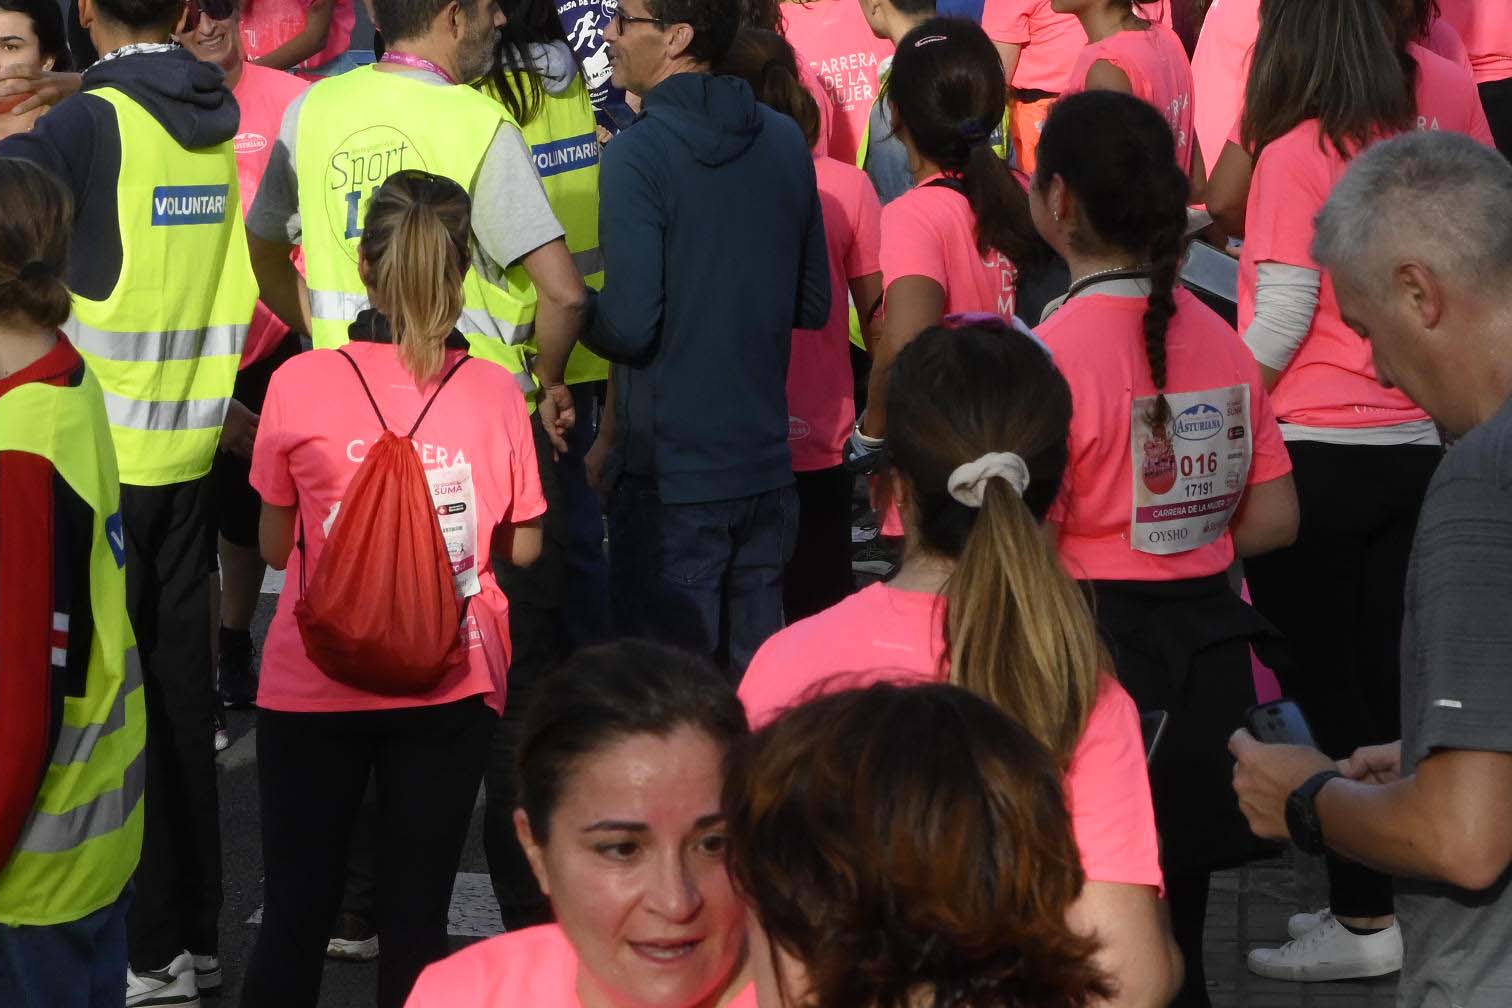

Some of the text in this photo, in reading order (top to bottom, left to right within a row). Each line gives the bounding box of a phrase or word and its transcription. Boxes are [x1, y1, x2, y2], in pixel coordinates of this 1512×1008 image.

[825, 69, 869, 91] DE LA
[331, 139, 409, 193] Sport
[1176, 419, 1220, 434] ASTURIANA
[1180, 451, 1217, 476] 016
[434, 484, 463, 496] SUMA
[1184, 481, 1214, 497] 17191
[1152, 506, 1186, 519] CARRERA
[1187, 505, 1197, 514] DE
[1198, 503, 1206, 512] LA
[1149, 527, 1189, 543] OYSHO
